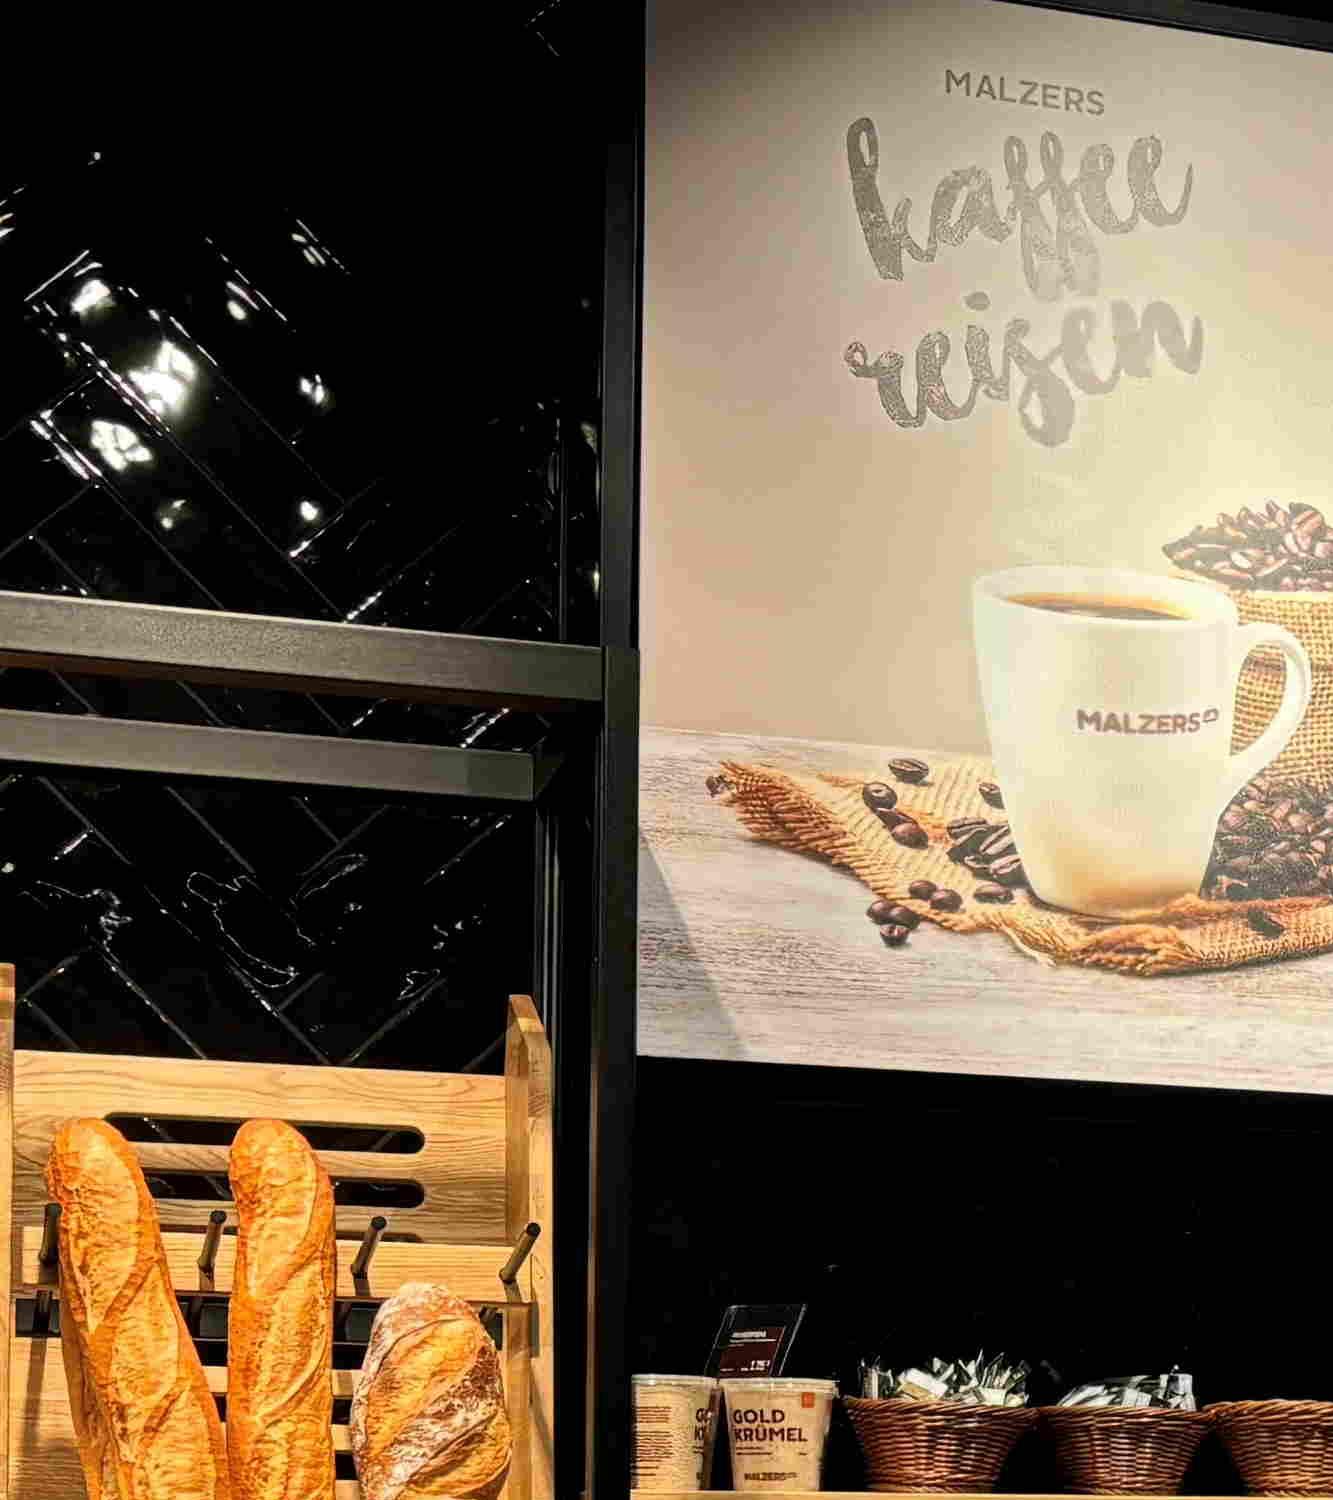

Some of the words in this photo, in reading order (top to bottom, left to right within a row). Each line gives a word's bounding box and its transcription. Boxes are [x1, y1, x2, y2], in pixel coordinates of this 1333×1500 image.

[944, 69, 1105, 116] MALZERS
[1076, 708, 1201, 735] MALZERS
[733, 1409, 785, 1424] GOLD
[734, 1424, 808, 1442] KRÜMEL
